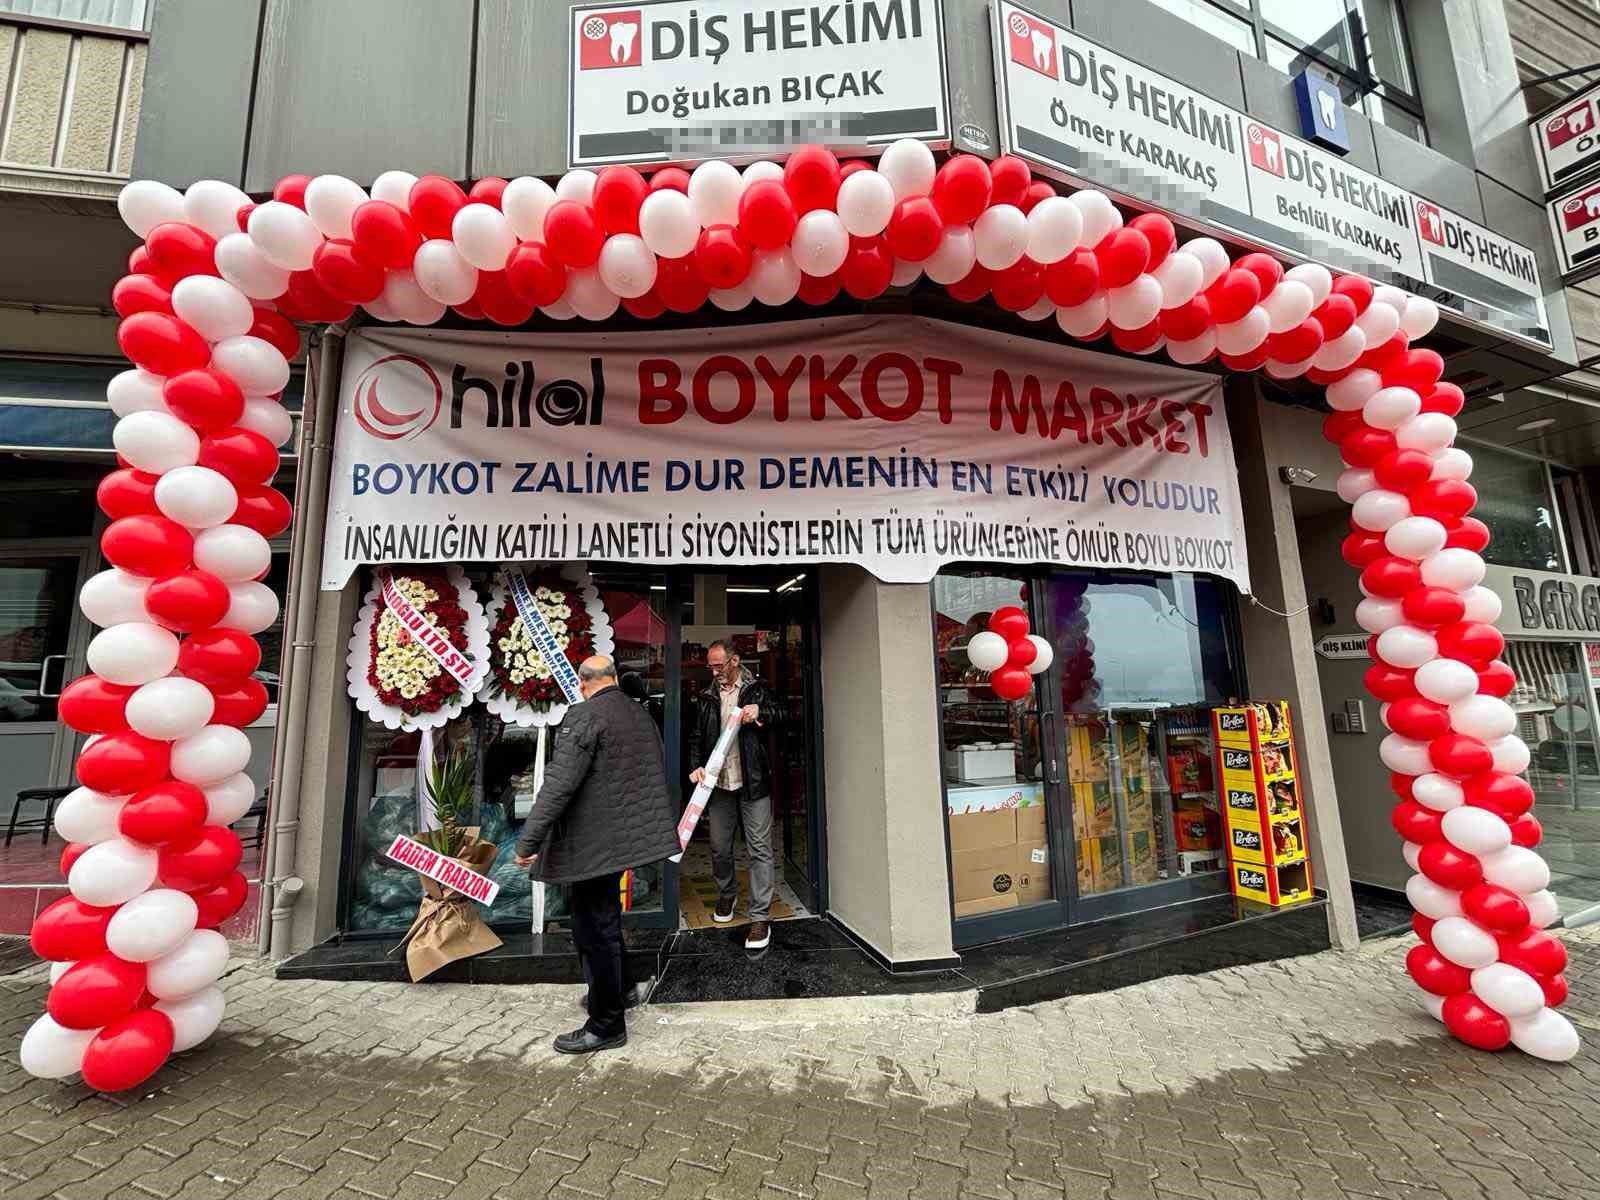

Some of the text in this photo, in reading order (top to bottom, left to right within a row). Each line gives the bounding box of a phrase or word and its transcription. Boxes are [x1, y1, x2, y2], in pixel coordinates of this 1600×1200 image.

[651, 10, 729, 65] DİŞ
[626, 70, 885, 118] Doğukan BIÇAK
[1062, 44, 1235, 154] DİŞ HEKİMİ
[1050, 97, 1116, 146] Ömer
[1119, 130, 1219, 191] KARAKAŞ
[1576, 134, 1600, 152] Ö
[1284, 148, 1410, 229] DİŞ HEKİMİ
[1276, 194, 1329, 231] Behlül
[1332, 216, 1402, 264] KARAKAŞ
[1443, 221, 1537, 286] DİŞ HEKİMİ
[450, 352, 1213, 457] hilal BOYKOT MARKET
[353, 447, 1220, 515] BOYKOT ZALİME DUR DEMENİN EN ETKİLİ YOLUDUR
[344, 508, 1234, 570] İNSANLIĞIN KATİLİ LANETLİ SİYONİSTLERİN TÜM ÜRÜNLERİNE ÖMÜR BOYU BOYKOT
[1513, 575, 1600, 632] BARA
[530, 609, 558, 652] METİN
[554, 651, 579, 688] GENÇ
[1341, 639, 1367, 651] KLİNİ
[390, 837, 493, 901] KADEM TRABZON
